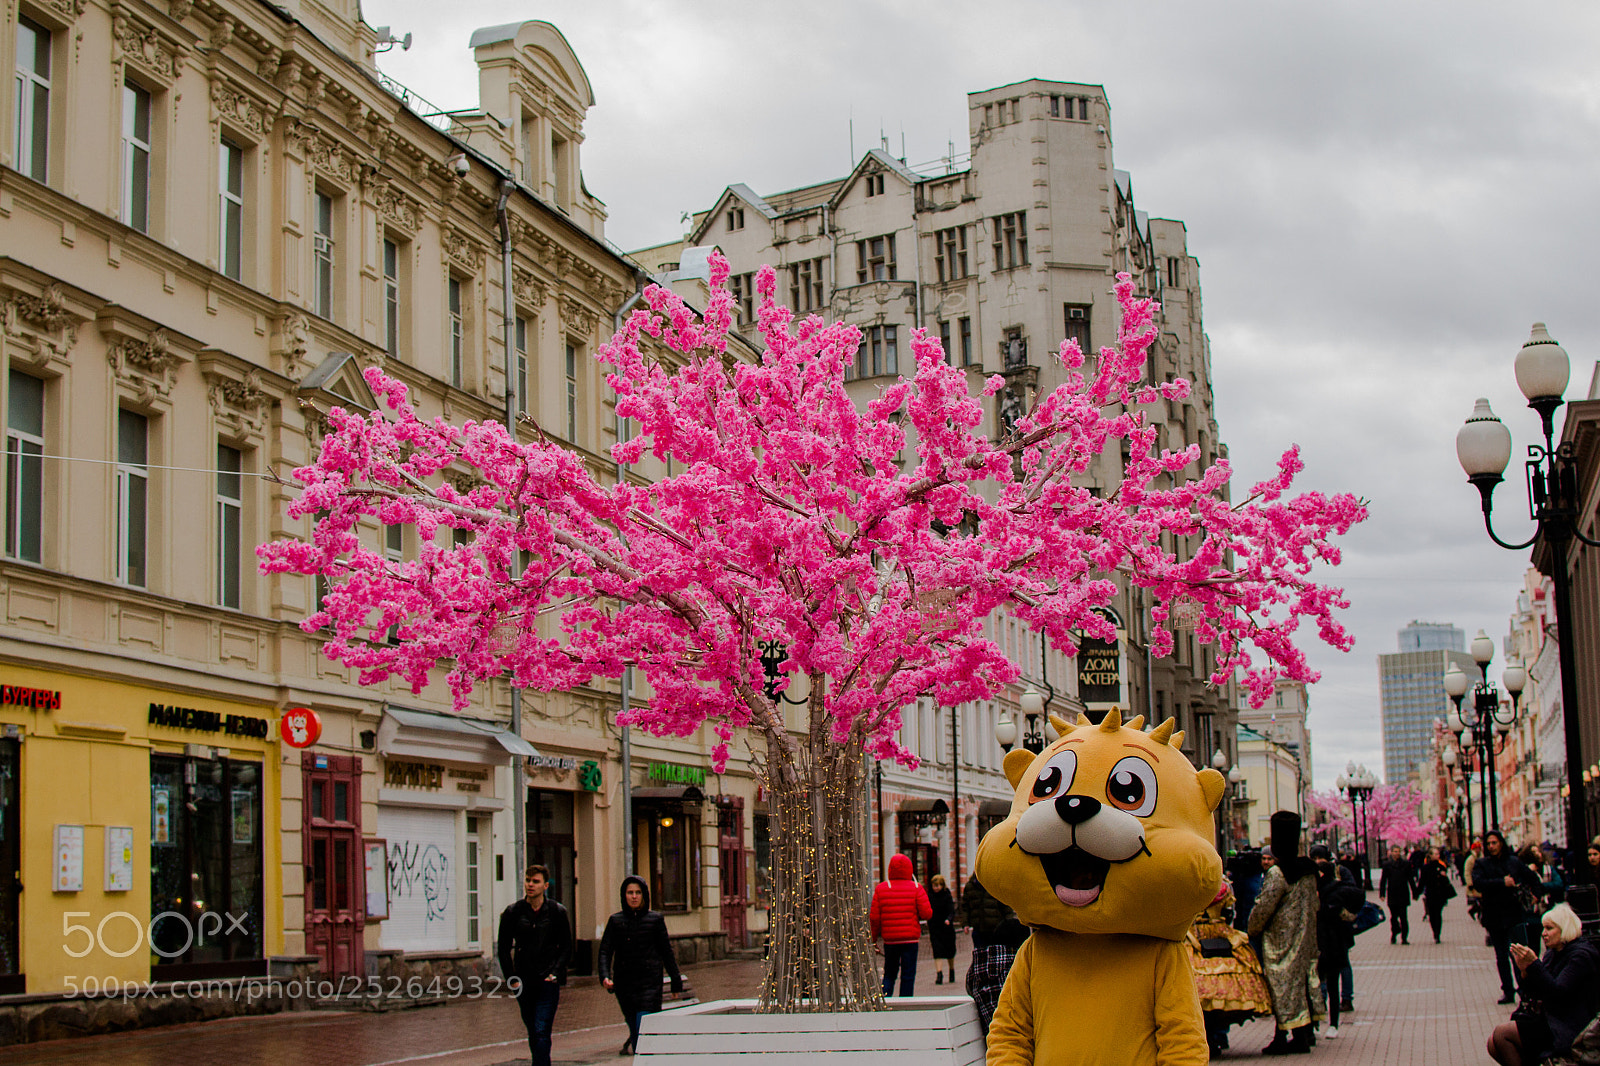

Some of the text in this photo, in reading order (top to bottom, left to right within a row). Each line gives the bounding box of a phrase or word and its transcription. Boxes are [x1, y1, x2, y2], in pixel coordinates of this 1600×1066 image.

[1083, 658, 1116, 671] ДОМ
[1079, 672, 1121, 685] АКТЕРА
[1, 684, 61, 710] БУРГЕРЫ
[647, 762, 707, 785] АНТИКВАРИАТ
